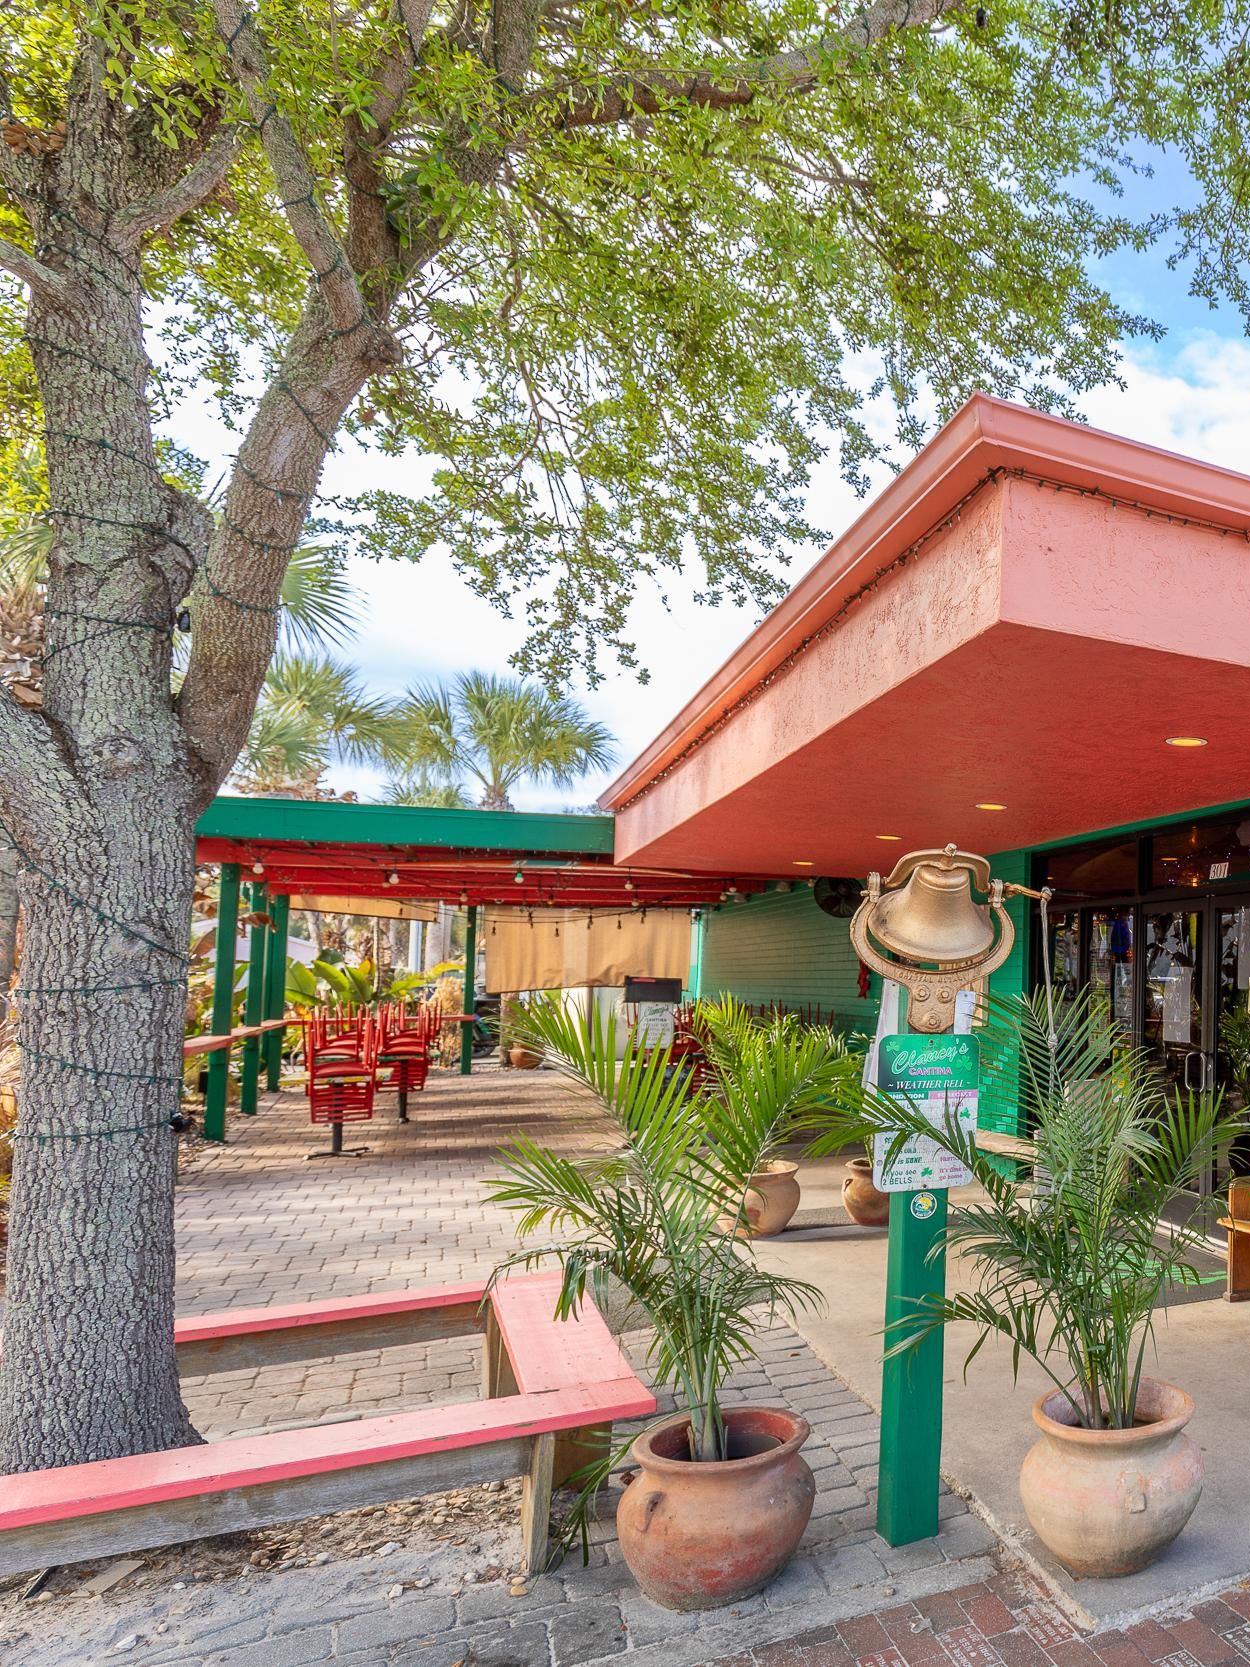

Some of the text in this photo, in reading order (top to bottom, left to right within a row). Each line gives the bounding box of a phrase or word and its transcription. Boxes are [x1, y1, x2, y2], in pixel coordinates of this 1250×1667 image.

[892, 1038, 969, 1074] Clancy's
[908, 1067, 953, 1076] CANTINA
[896, 1080, 963, 1090] WEATHER BELL
[889, 1177, 913, 1185] BELLS
